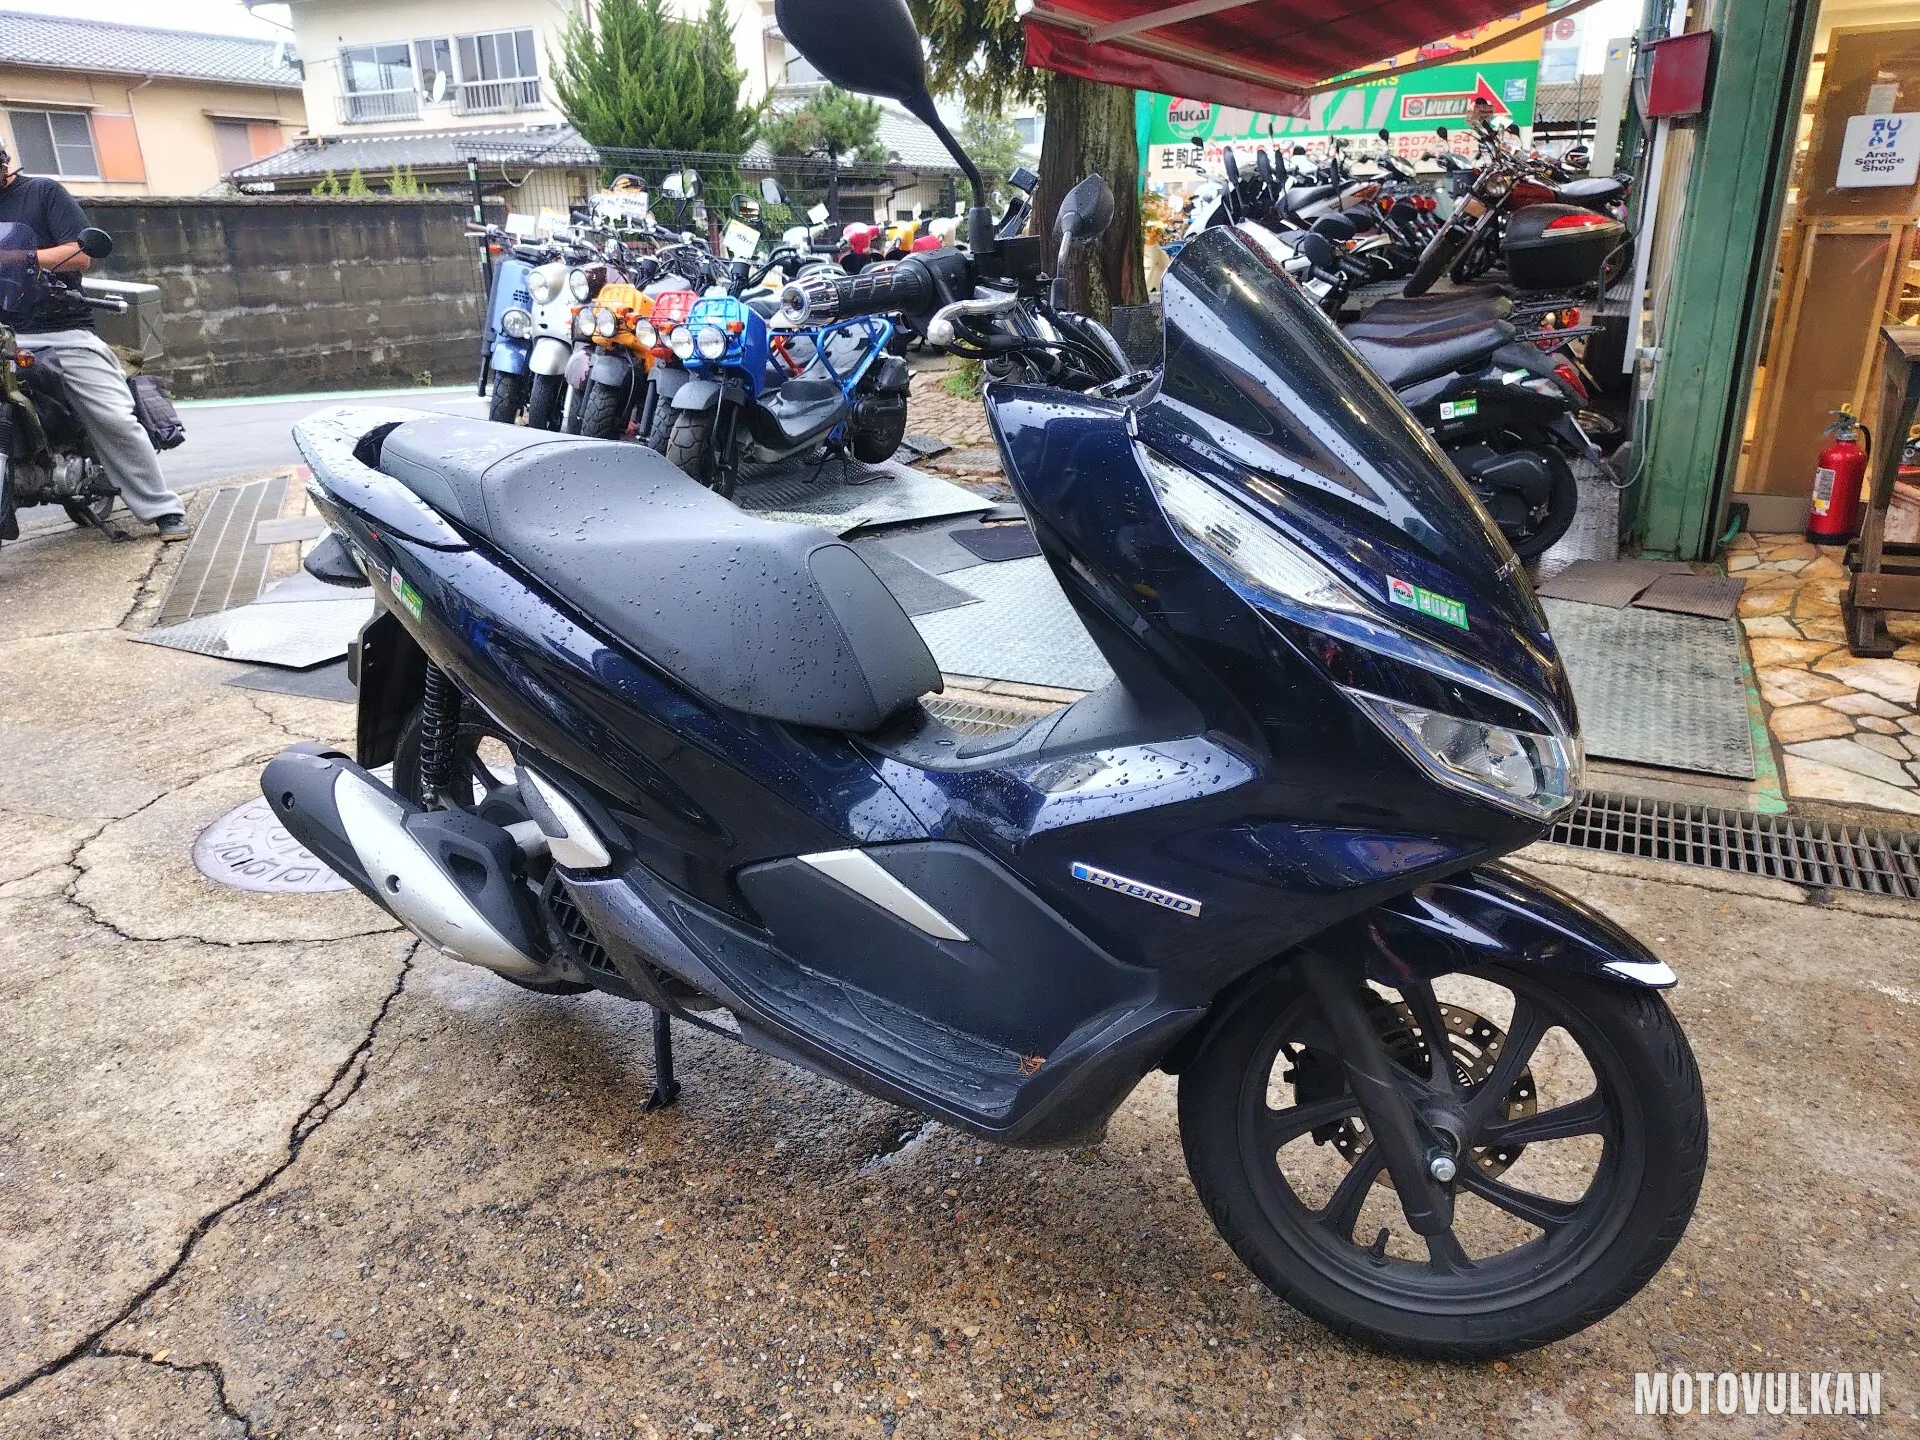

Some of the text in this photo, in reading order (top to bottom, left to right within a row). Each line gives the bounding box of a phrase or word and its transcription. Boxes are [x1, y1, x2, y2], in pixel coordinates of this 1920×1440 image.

[1864, 151, 1897, 159] Area
[1854, 157, 1905, 166] Service
[1861, 164, 1895, 173] Shop
[1090, 872, 1193, 912] HYBRID
